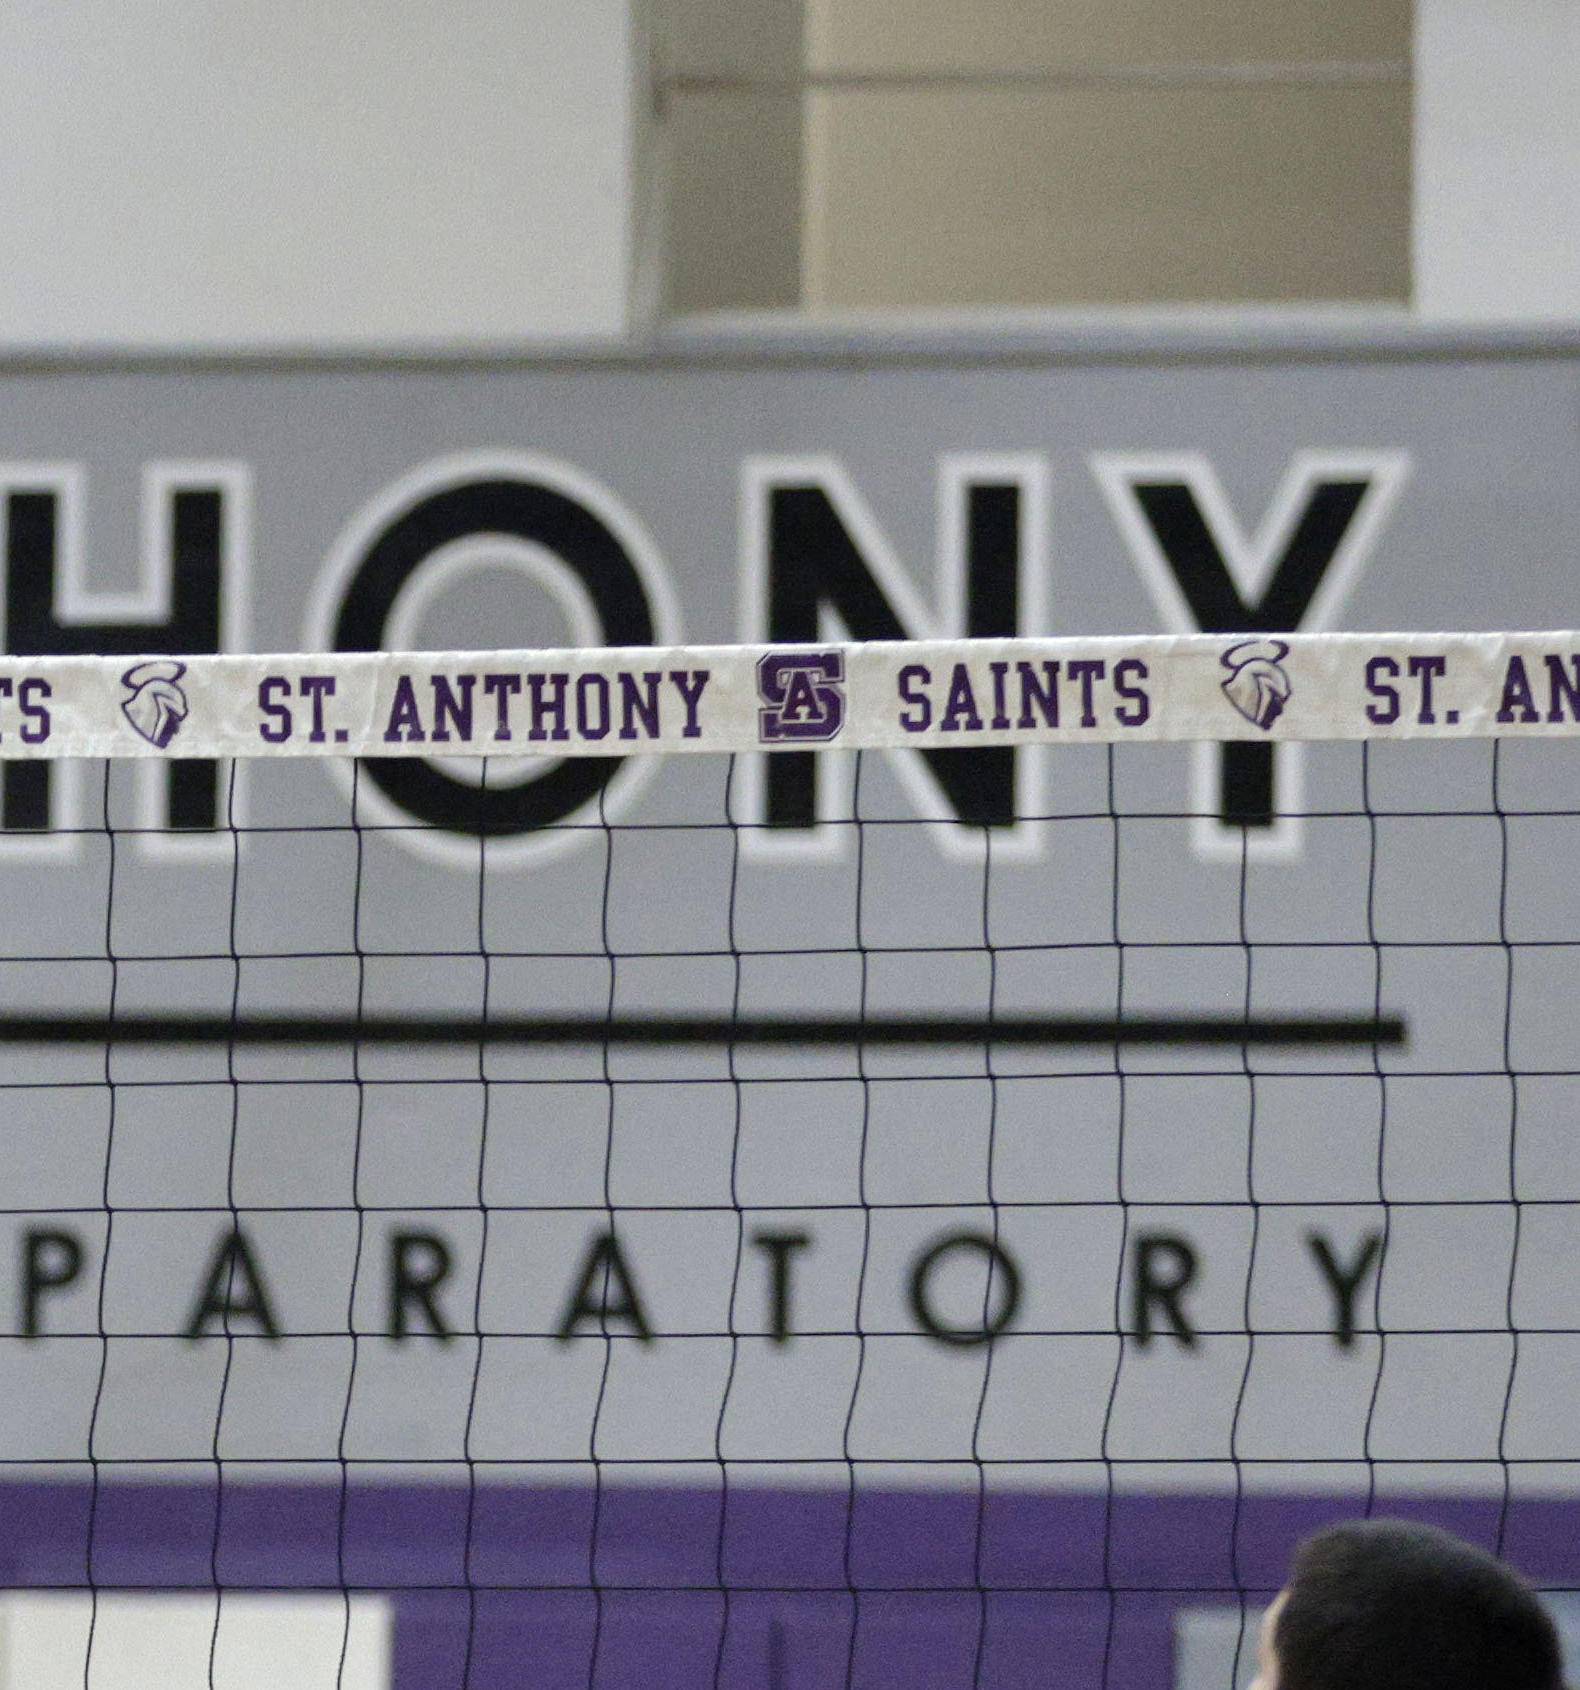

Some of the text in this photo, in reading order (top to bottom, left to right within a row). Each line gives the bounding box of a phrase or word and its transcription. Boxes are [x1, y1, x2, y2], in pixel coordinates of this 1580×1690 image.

[259, 676, 348, 743] ST.
[384, 669, 709, 742] ANTHONY
[899, 659, 1150, 733] SAINTS
[1365, 655, 1460, 725] ST.
